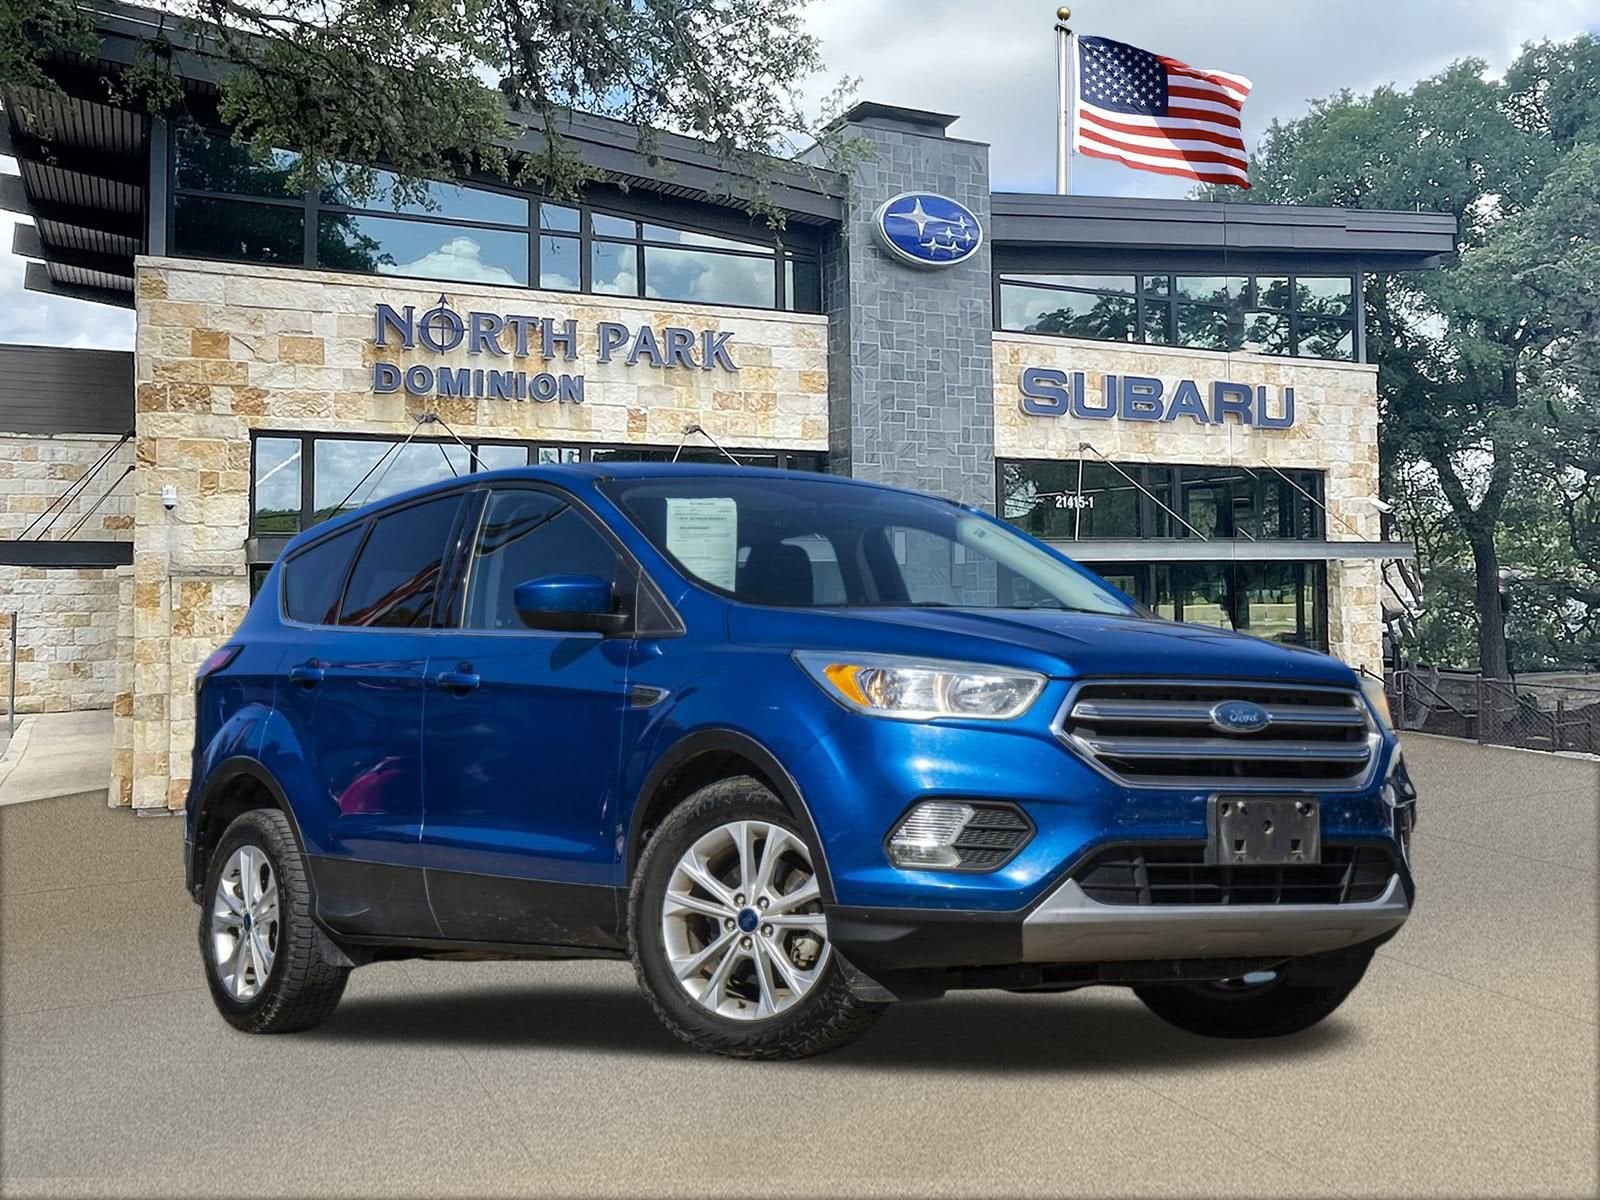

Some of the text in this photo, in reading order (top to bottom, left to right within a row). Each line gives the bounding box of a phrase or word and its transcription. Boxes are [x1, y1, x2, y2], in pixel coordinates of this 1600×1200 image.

[374, 296, 741, 373] NORTH PARK
[373, 362, 585, 405] DOMINION
[1018, 366, 1295, 430] SUBARU
[1229, 709, 1259, 723] Ford
